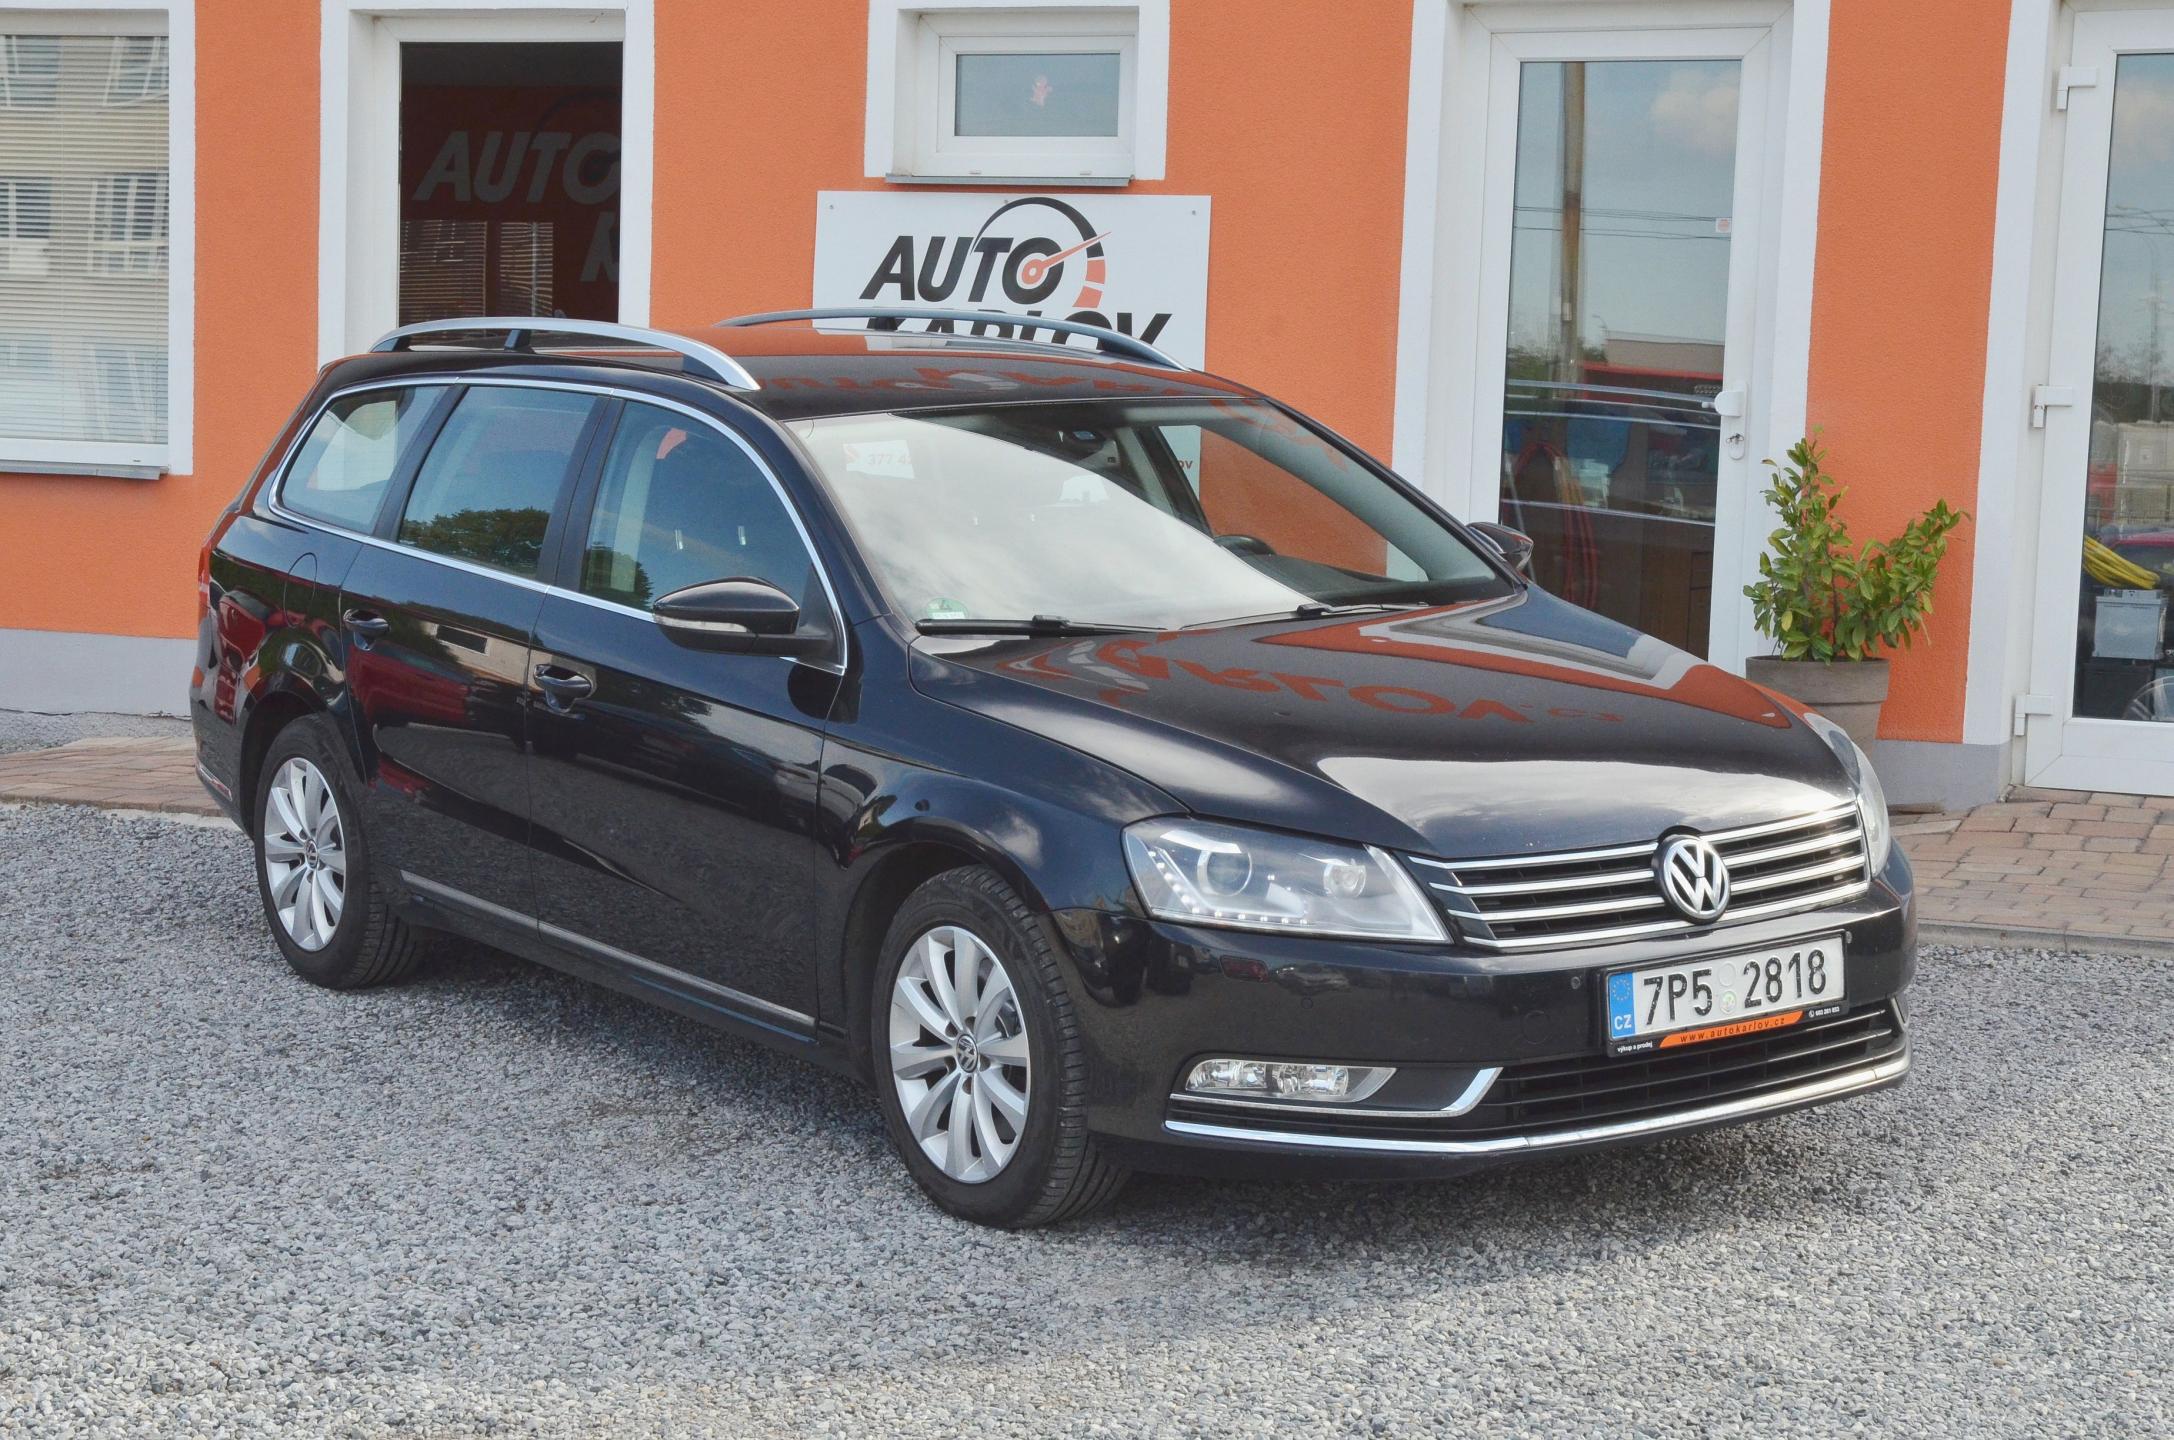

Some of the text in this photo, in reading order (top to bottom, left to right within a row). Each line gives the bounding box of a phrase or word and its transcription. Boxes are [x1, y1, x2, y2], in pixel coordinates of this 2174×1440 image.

[860, 235, 1065, 305] AUTO
[1643, 948, 1827, 1026] 7P5 2818
[1613, 1013, 1633, 1031] CZ
[1679, 1017, 1786, 1043] www.autokarlov.cz
